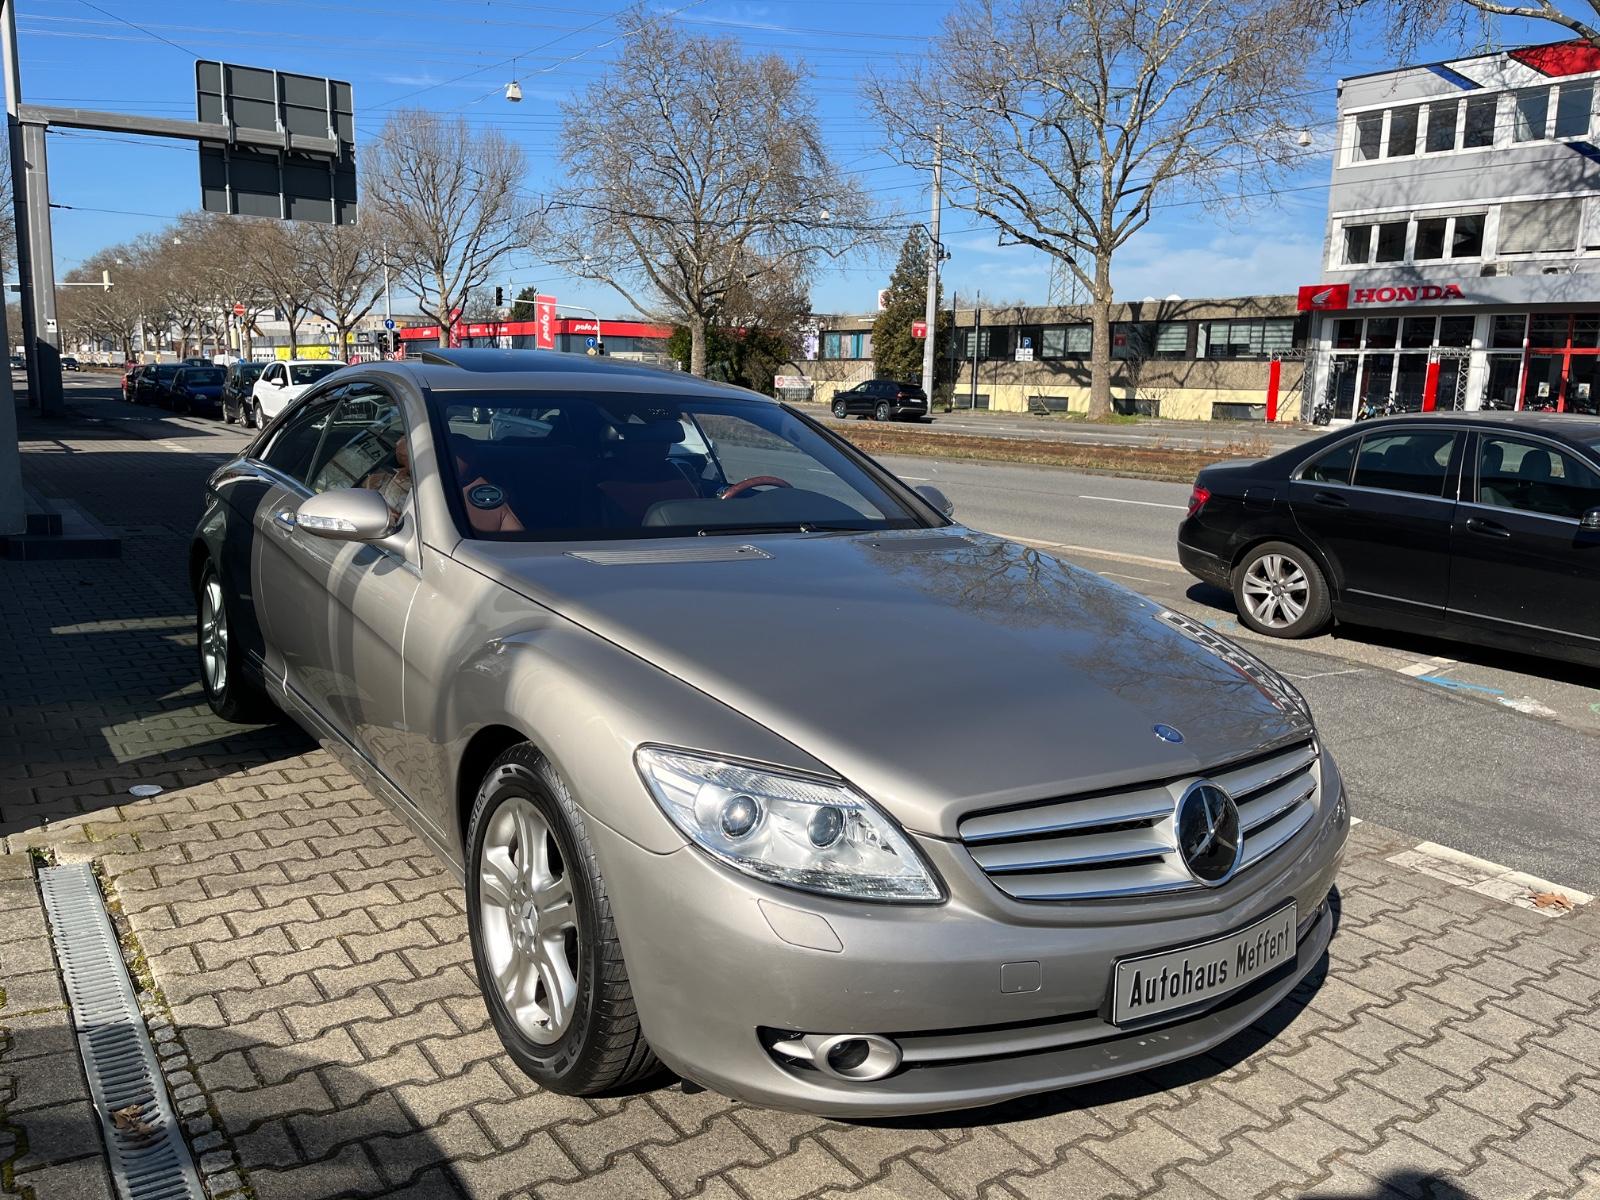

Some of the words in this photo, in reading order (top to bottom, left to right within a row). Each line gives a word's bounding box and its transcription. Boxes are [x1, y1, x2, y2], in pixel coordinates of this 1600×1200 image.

[1353, 284, 1466, 304] HONDA
[540, 314, 551, 342] polo
[574, 323, 592, 332] polo
[1128, 958, 1227, 1008] Autohaus
[1235, 921, 1290, 979] Meffert
